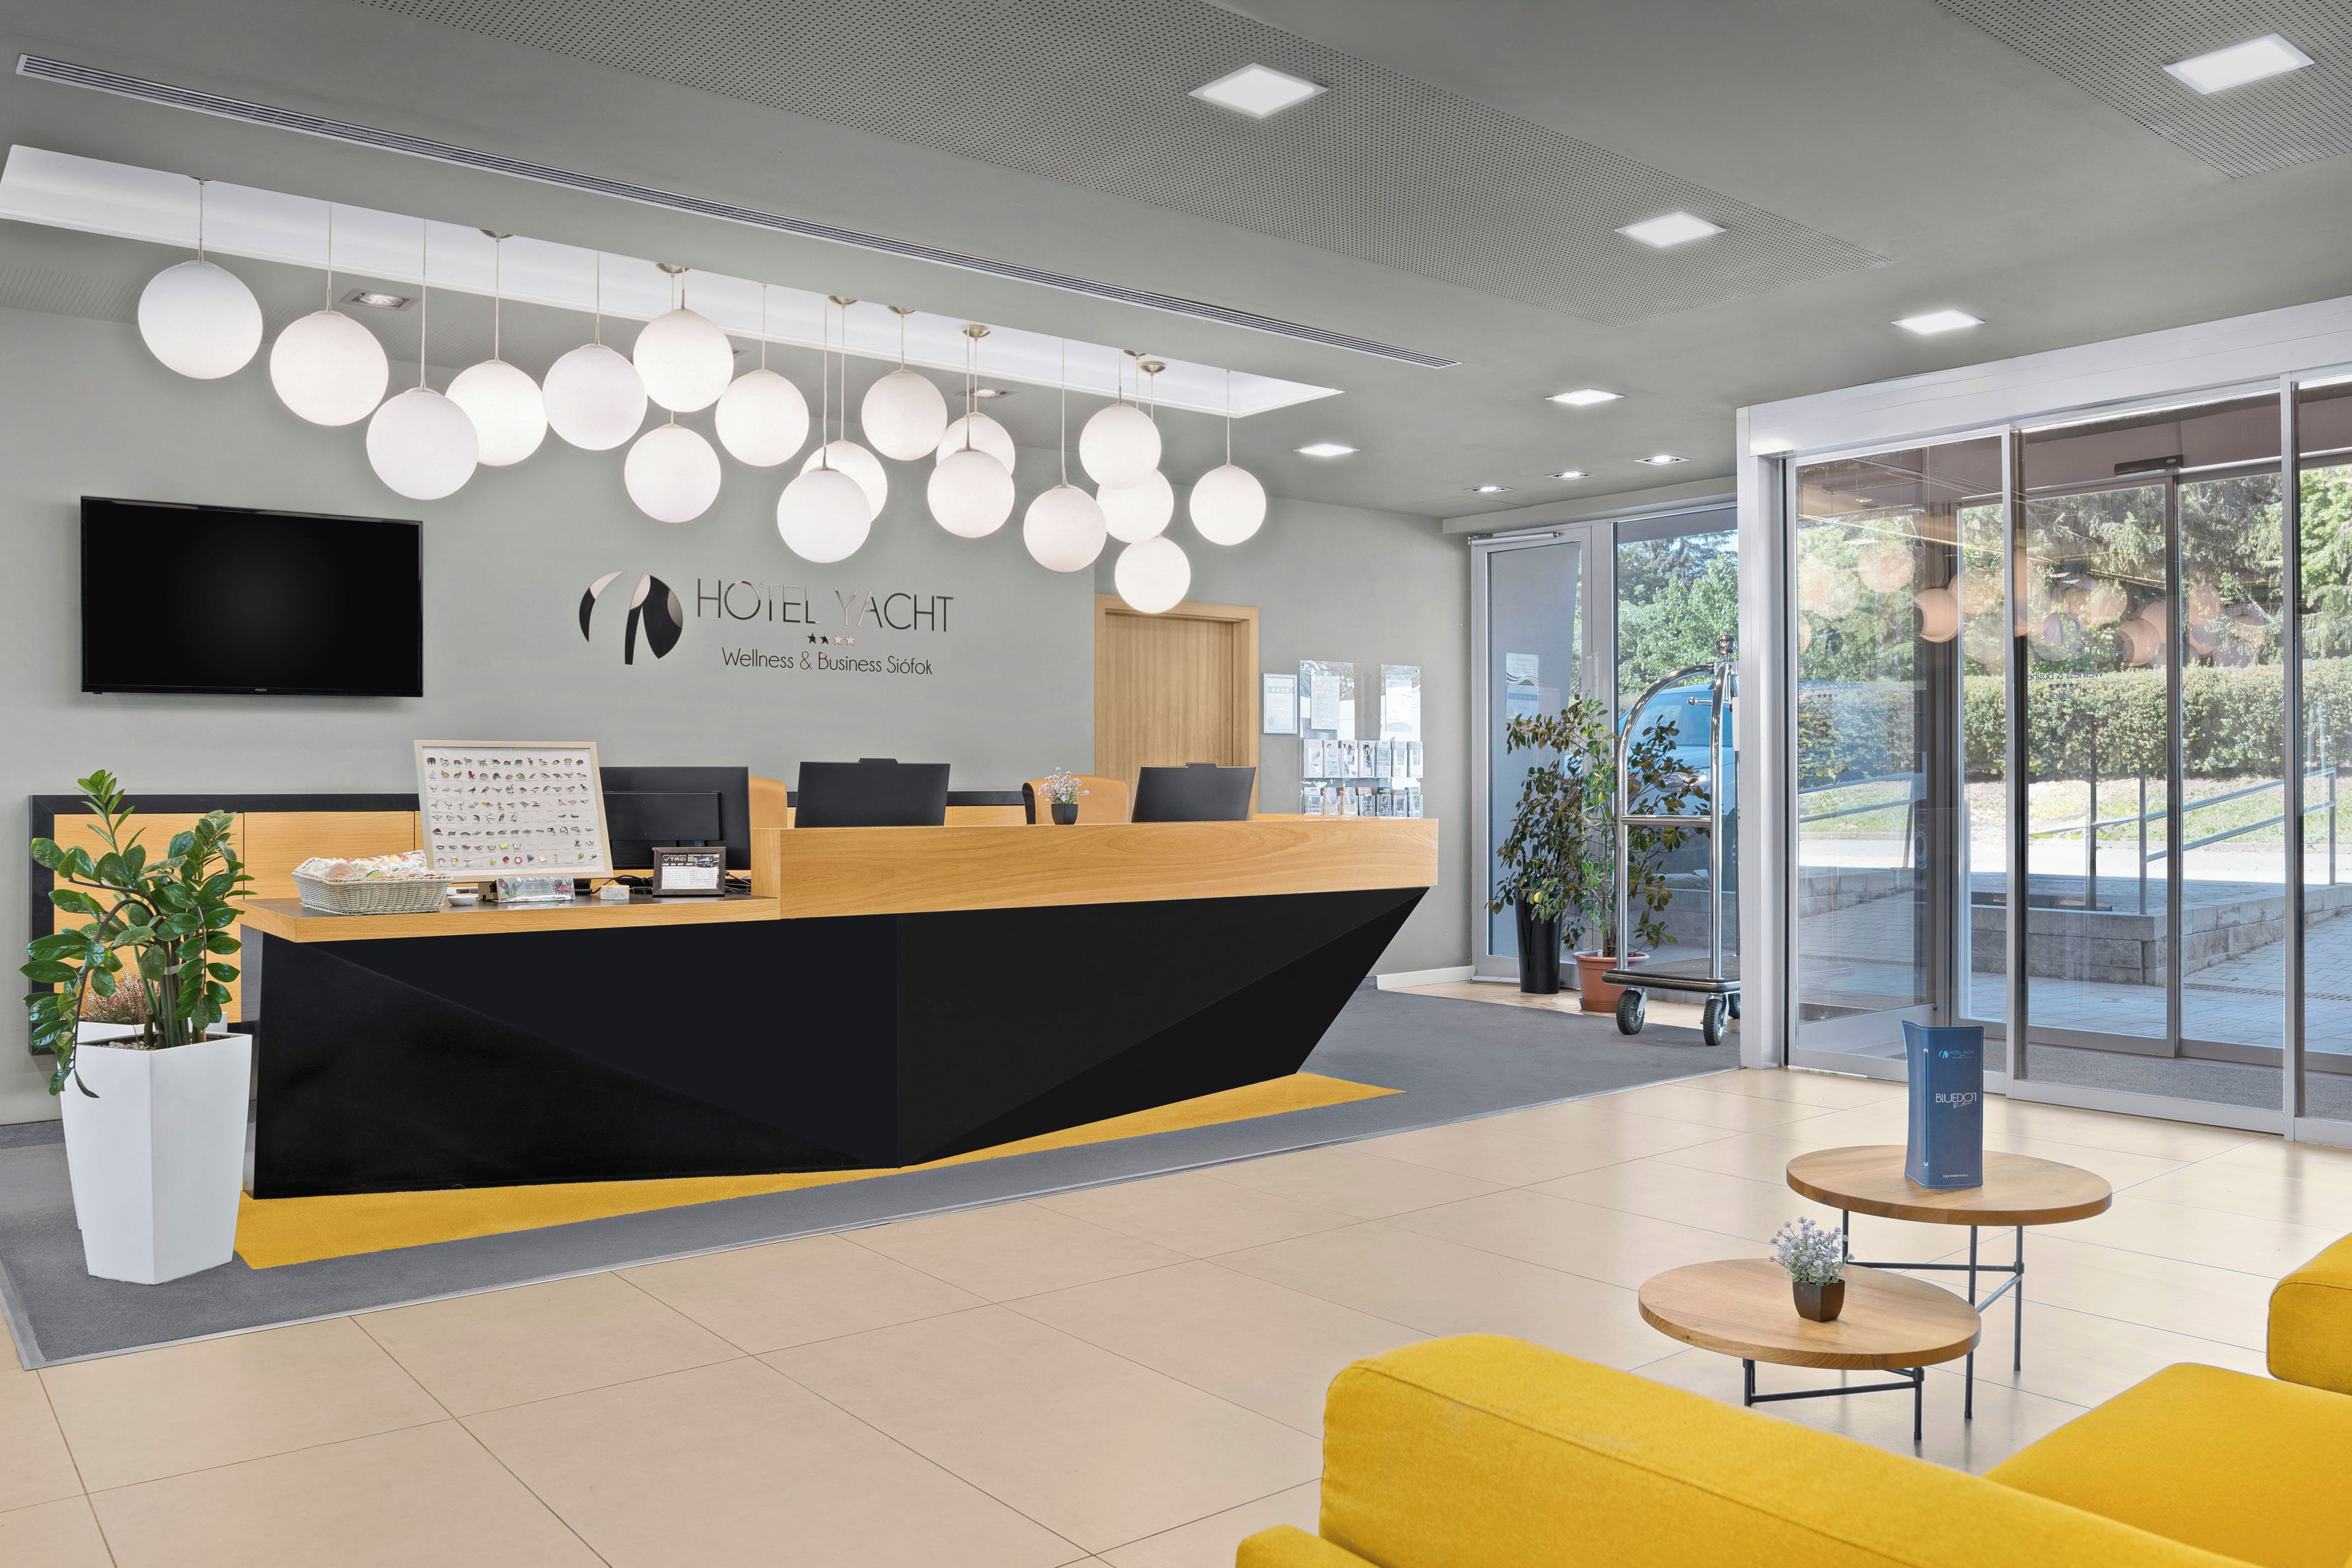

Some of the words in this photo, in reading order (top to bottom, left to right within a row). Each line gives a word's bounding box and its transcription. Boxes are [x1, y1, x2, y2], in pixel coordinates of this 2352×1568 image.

[697, 578, 821, 624] HOTEL
[834, 586, 954, 632] YACHT
[722, 647, 794, 669] Wellness
[800, 652, 812, 671] &
[818, 652, 882, 673] Business
[887, 656, 933, 675] Siófok
[1936, 1092, 1977, 1103] BLUEDOT
